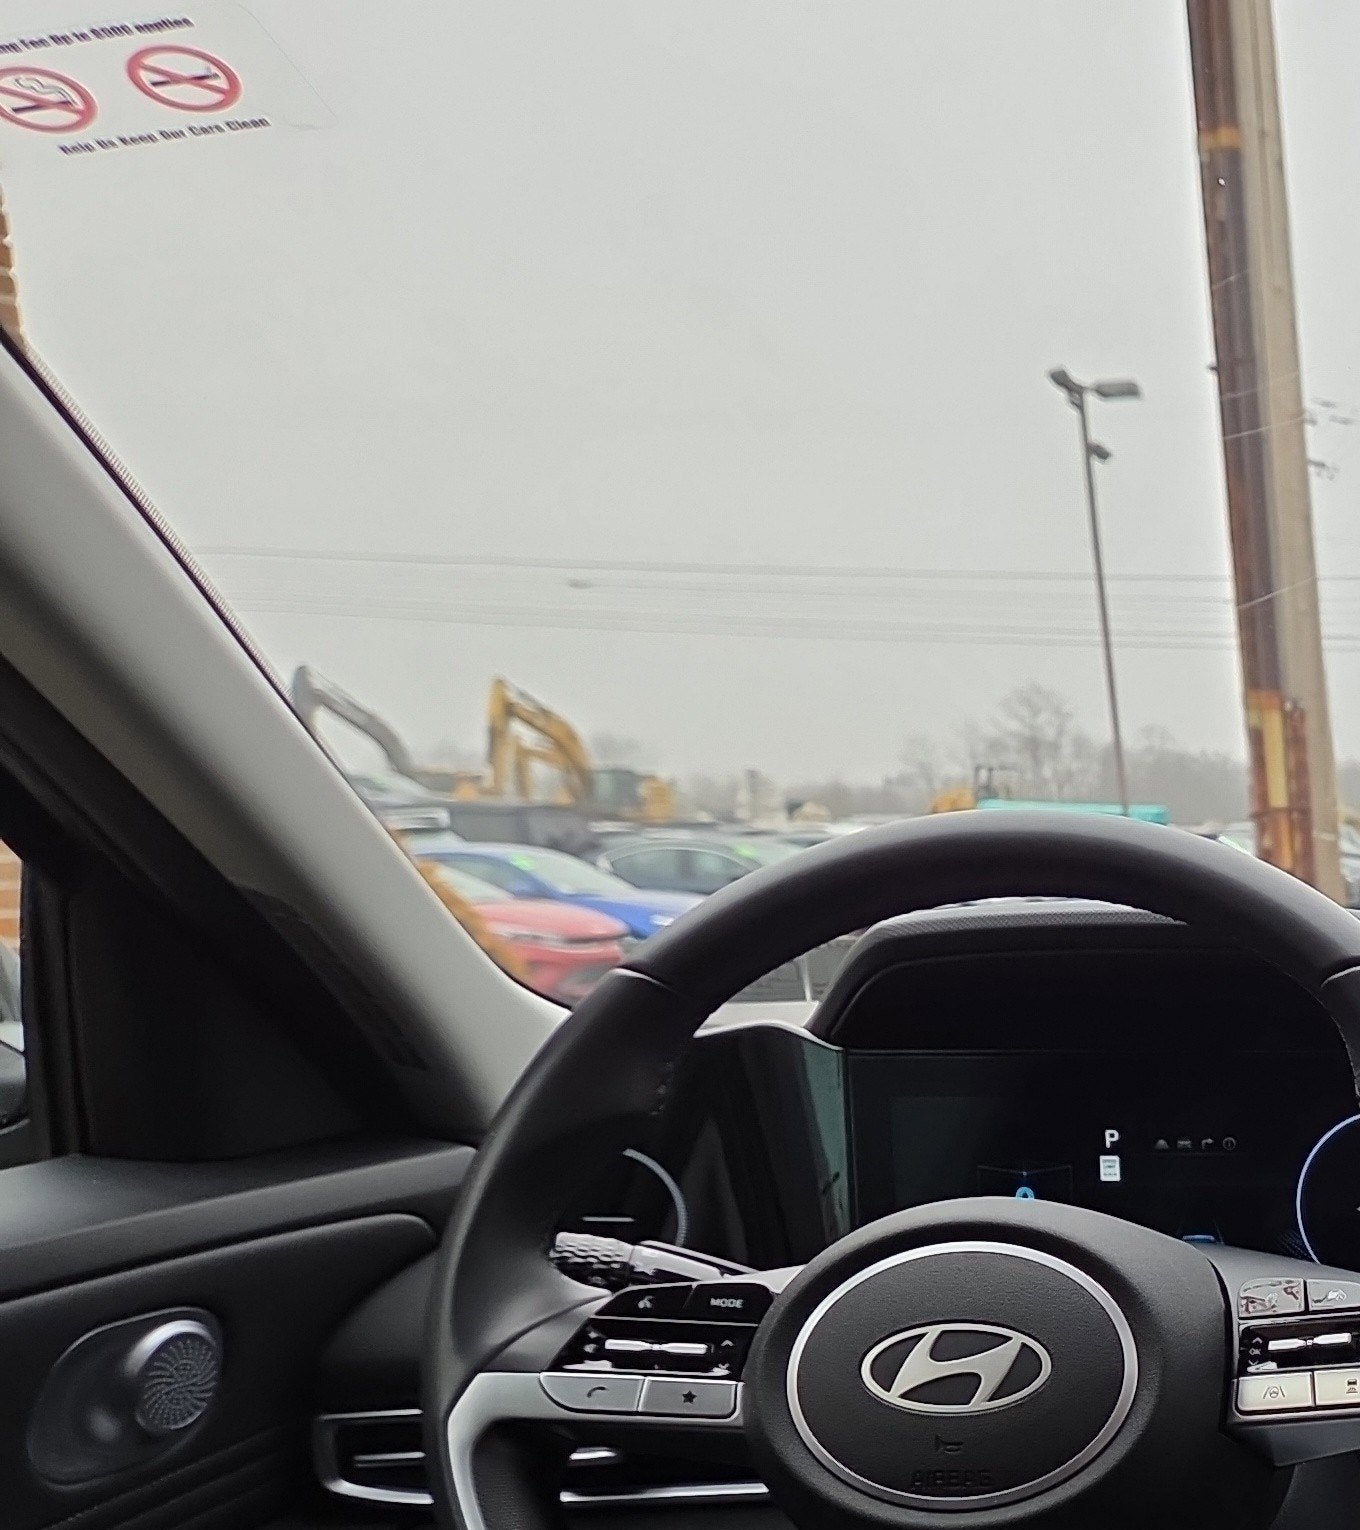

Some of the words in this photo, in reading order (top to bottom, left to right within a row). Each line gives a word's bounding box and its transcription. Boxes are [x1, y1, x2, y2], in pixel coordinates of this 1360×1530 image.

[58, 141, 96, 156] Help
[117, 133, 159, 147] Keep
[158, 128, 187, 140] Our
[186, 123, 227, 137] Cars
[224, 116, 271, 132] Clean
[1105, 1129, 1119, 1148] P
[710, 1297, 743, 1309] MODE
